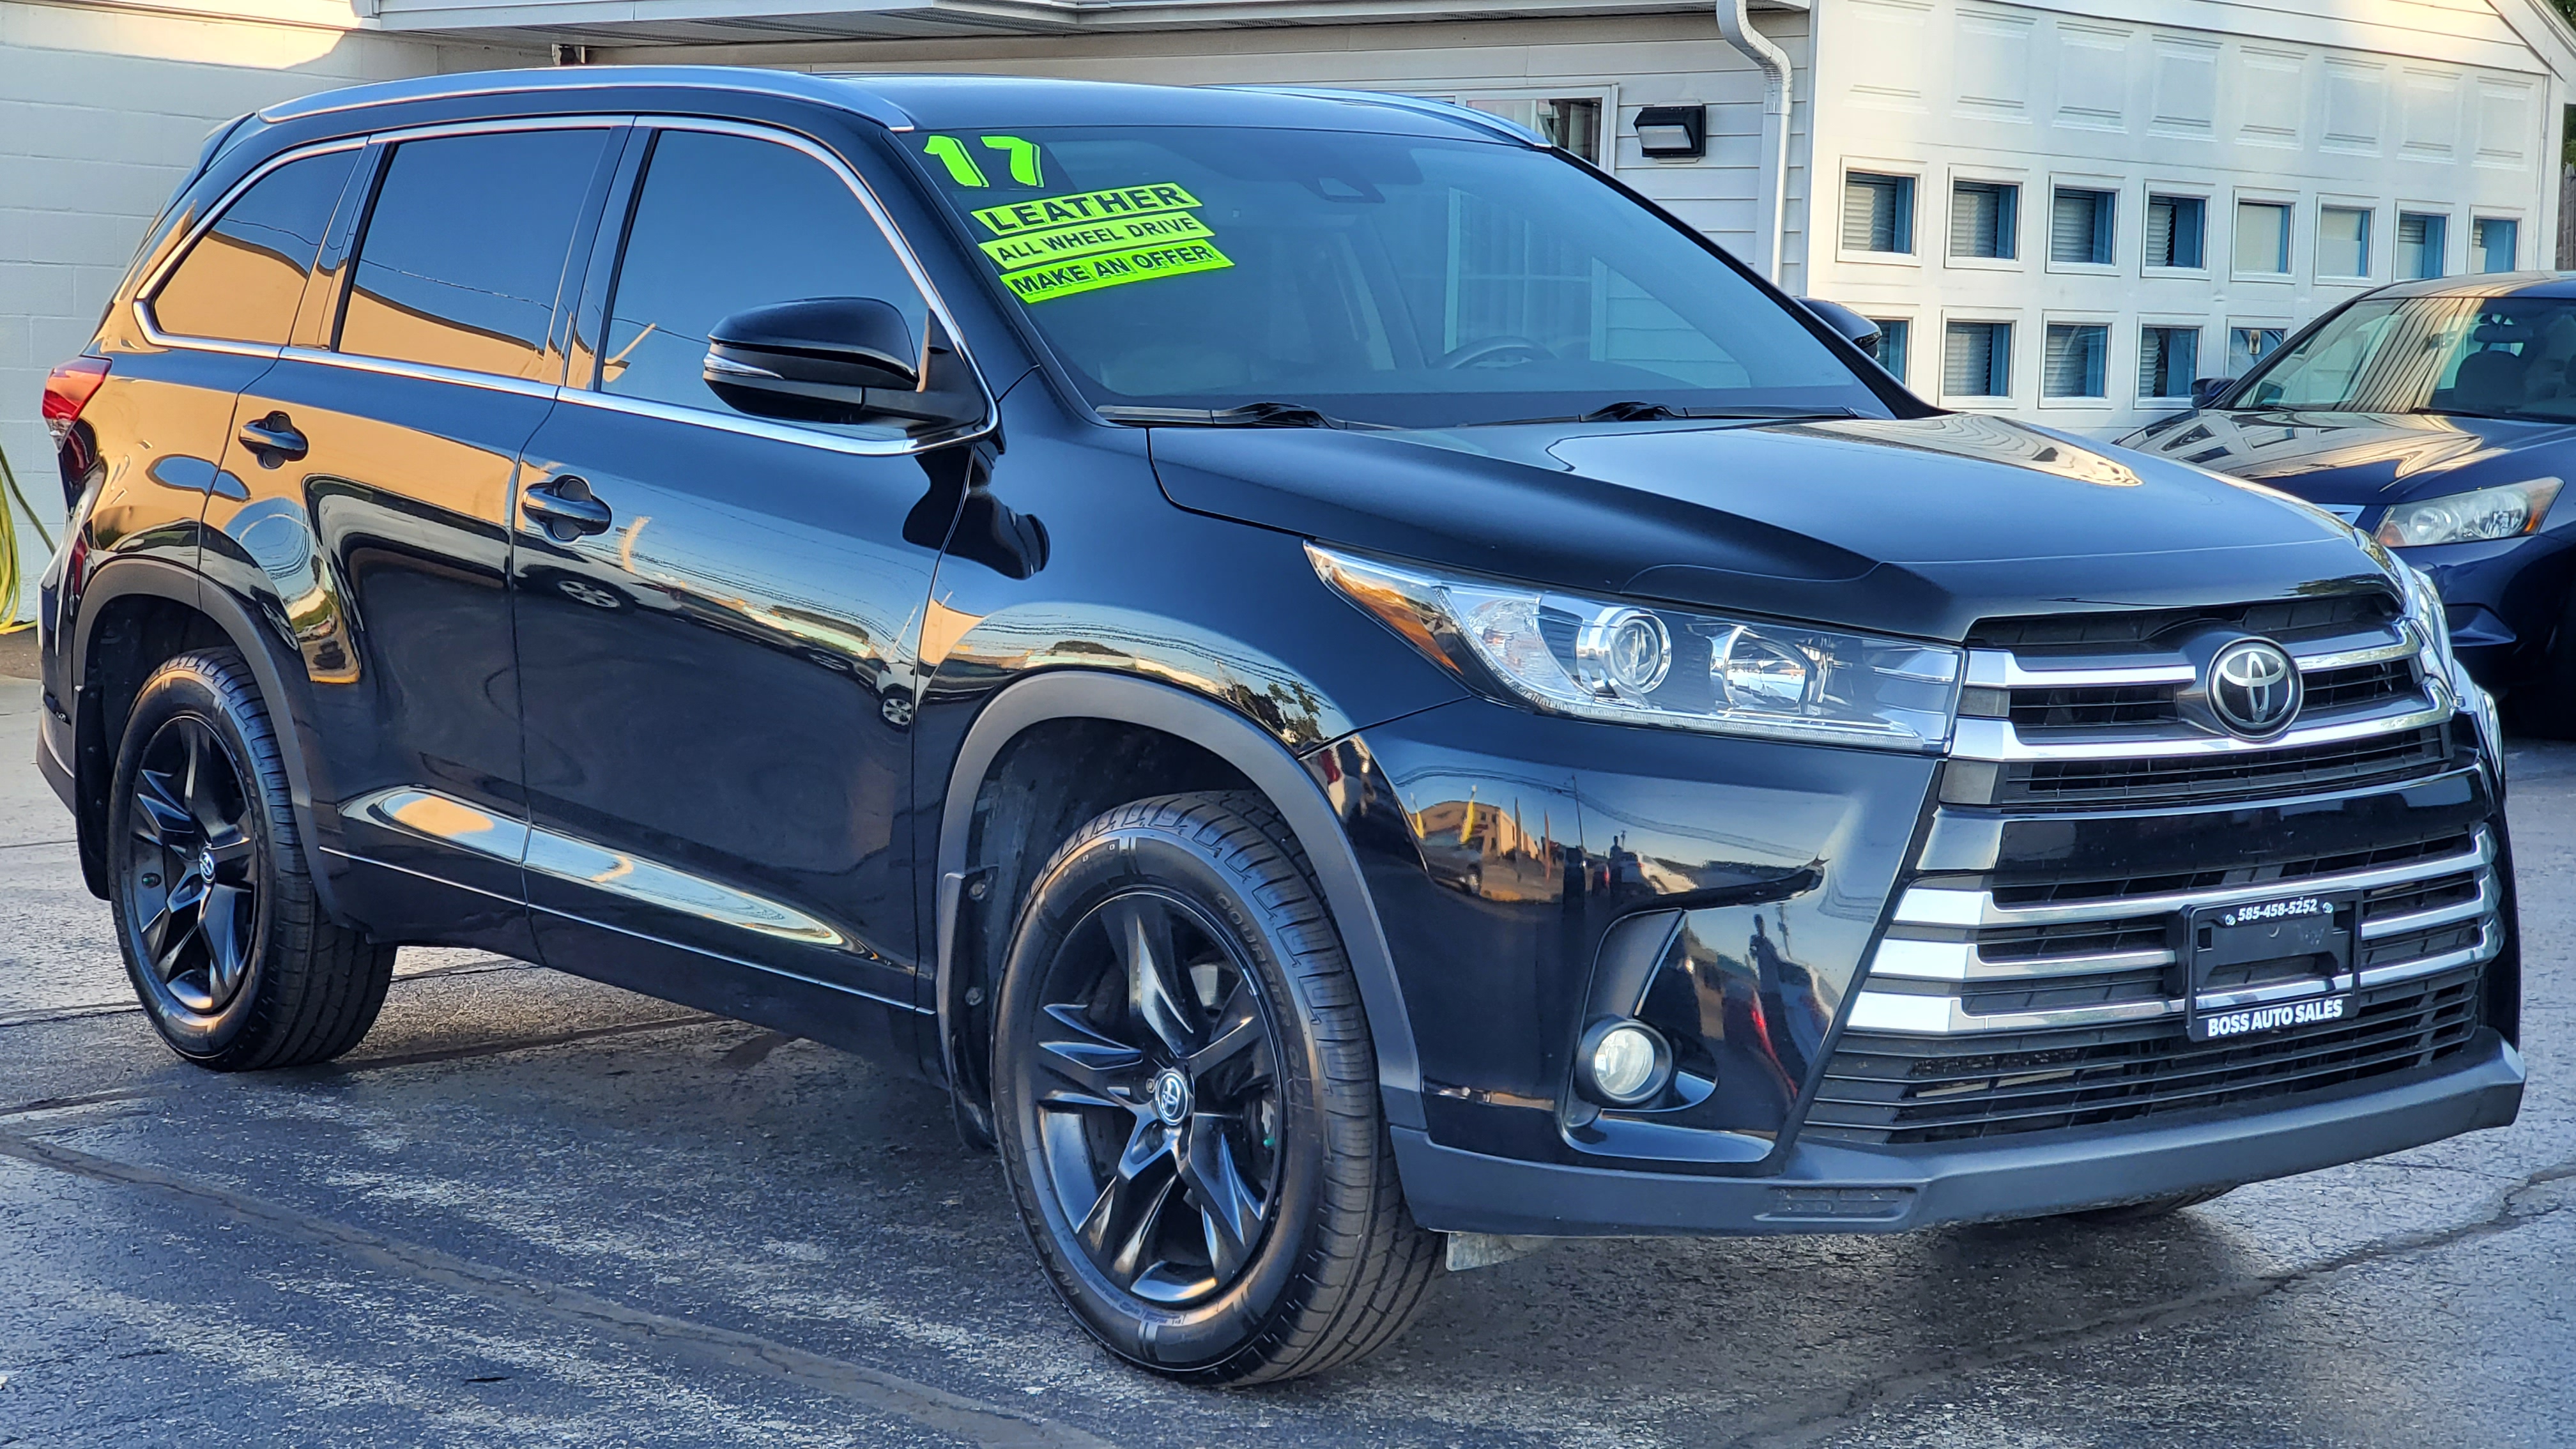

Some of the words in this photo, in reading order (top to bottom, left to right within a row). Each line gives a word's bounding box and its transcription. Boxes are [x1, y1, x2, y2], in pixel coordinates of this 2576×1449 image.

[923, 135, 1045, 188] 17
[984, 186, 1192, 231] LEATHER
[995, 242, 1041, 262] ALL
[1039, 227, 1124, 252] WHEEL
[1124, 217, 1201, 238] DRIVE
[1010, 265, 1088, 294] MAKE
[1096, 257, 1131, 278] AN
[1135, 245, 1215, 270] OFFER
[2237, 898, 2318, 921] 585-458-5252
[2207, 1013, 2250, 1037] BOSS
[2251, 1006, 2294, 1031] AUTO
[2294, 999, 2343, 1022] SALES
